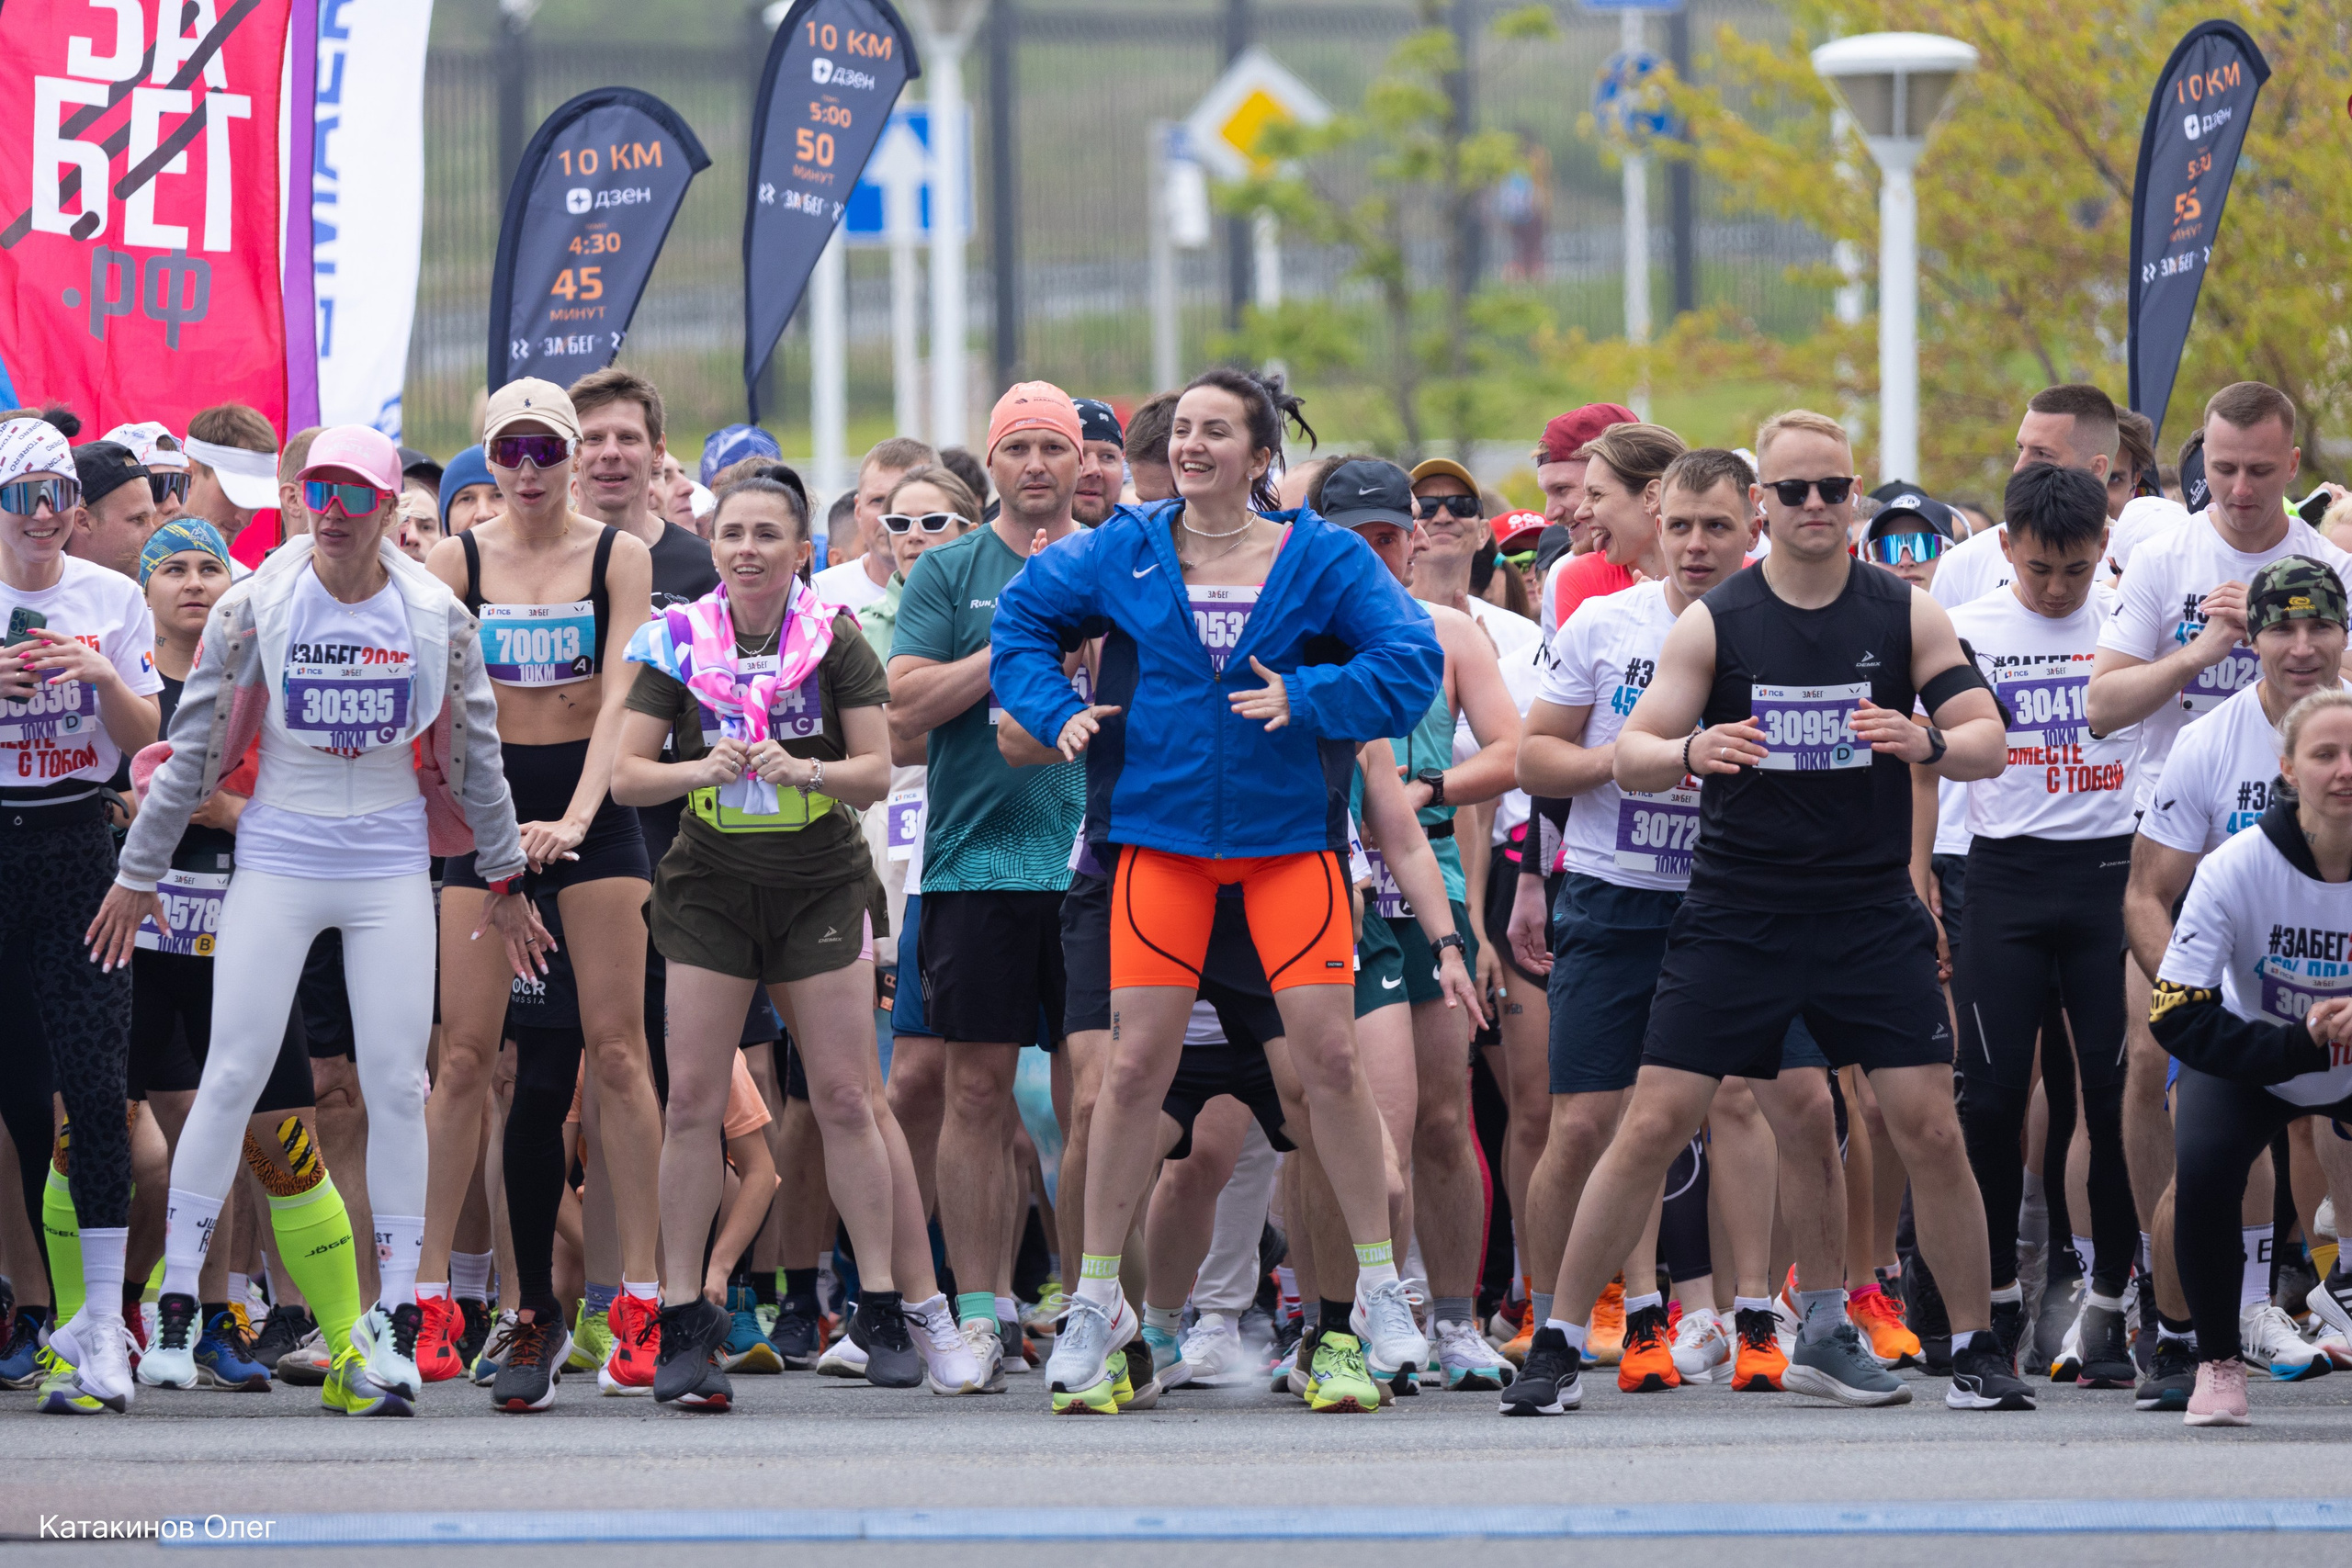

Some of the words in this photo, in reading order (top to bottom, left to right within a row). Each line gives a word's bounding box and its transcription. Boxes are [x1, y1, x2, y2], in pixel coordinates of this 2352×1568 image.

[806, 21, 838, 51] 10
[2177, 74, 2203, 104] 10
[809, 102, 852, 129] 5:00
[559, 148, 598, 176] 10
[796, 127, 834, 167] 50
[31, 75, 251, 253] БЕГ
[792, 164, 835, 186] МИНУТ
[569, 231, 621, 255] 4:30
[550, 266, 604, 301] 45
[549, 306, 606, 321] МИНУТ
[9, 440, 39, 472] TORERO
[496, 626, 580, 663] 70013
[303, 688, 395, 724] 30335
[66, 715, 78, 729] D
[1765, 707, 1858, 746] 30954
[18, 751, 32, 777] С
[37, 741, 98, 778] ТОБОЙ
[1838, 747, 1849, 760] D
[2046, 766, 2060, 794] С
[2065, 759, 2124, 794] ТОБОЙ
[900, 808, 922, 840] 3
[141, 892, 221, 933] 578
[199, 938, 210, 951] B
[511, 995, 546, 1005] RUSSIA
[512, 977, 547, 996] OCR
[304, 1235, 352, 1258] JÖGEL
